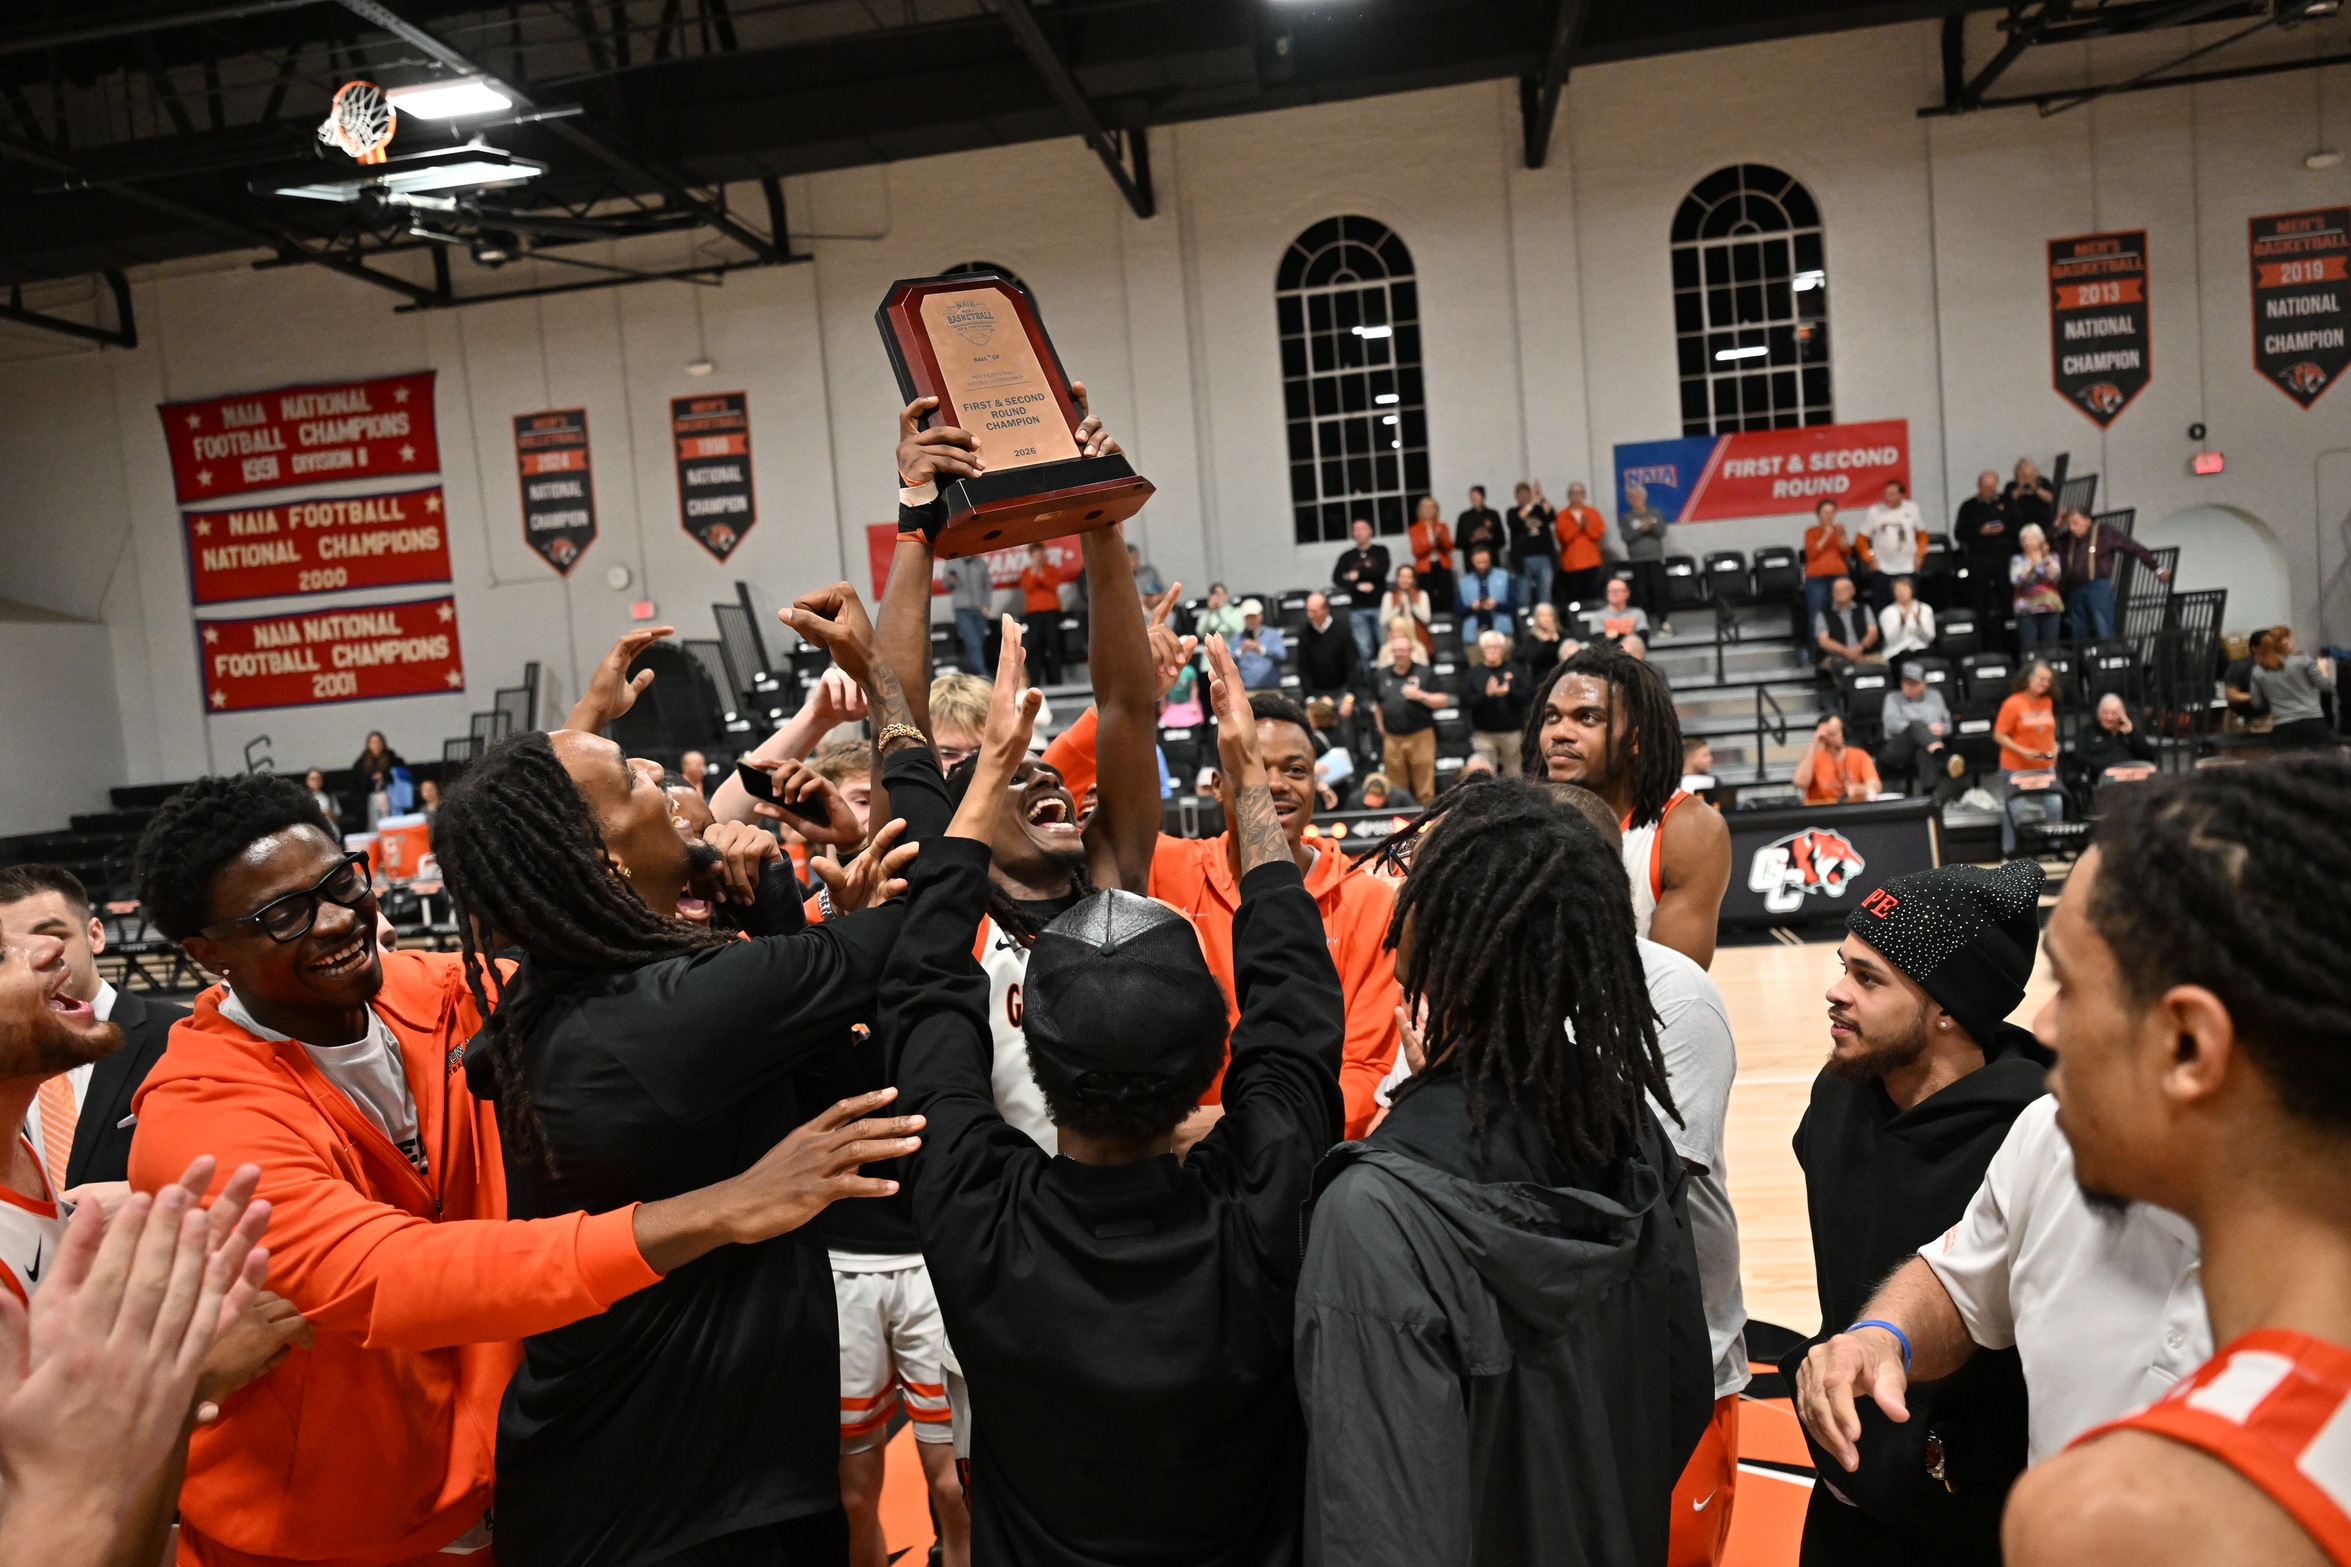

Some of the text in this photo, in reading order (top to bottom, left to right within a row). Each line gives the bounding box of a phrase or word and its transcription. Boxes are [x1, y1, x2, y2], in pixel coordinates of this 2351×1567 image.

[2280, 259, 2324, 284] 2019
[2077, 281, 2120, 305] 2013
[947, 311, 994, 324] BASKETBALL
[2266, 293, 2341, 319] NATIONAL
[2064, 314, 2136, 341] NATIONAL
[2264, 328, 2345, 355] CHAMPION
[2062, 349, 2141, 376] CHAMPION
[221, 389, 373, 429] NAIA NATIONAL
[963, 393, 1046, 412] FIRST & SECOND
[991, 406, 1027, 419] ROUND
[986, 415, 1041, 431] CHAMPION
[193, 411, 410, 461] FOOTBALL CHAMPIONS
[1014, 447, 1036, 457] 2026
[1722, 446, 1899, 480] FIRST & SECOND
[686, 463, 744, 486] NATIONAL
[1773, 475, 1850, 499] ROUND
[529, 480, 584, 500] NATIONAL
[228, 497, 406, 536] NAIA FOOTBALL
[686, 494, 748, 517] CHAMPION
[529, 508, 589, 531] CHAMPION
[202, 527, 440, 572] NATIONAL CHAMPIONS
[299, 567, 348, 591] 2000
[253, 611, 403, 648] NAIA NATIONAL
[214, 634, 450, 678] FOOTBALL CHAMPIONS
[312, 671, 357, 698] 2001
